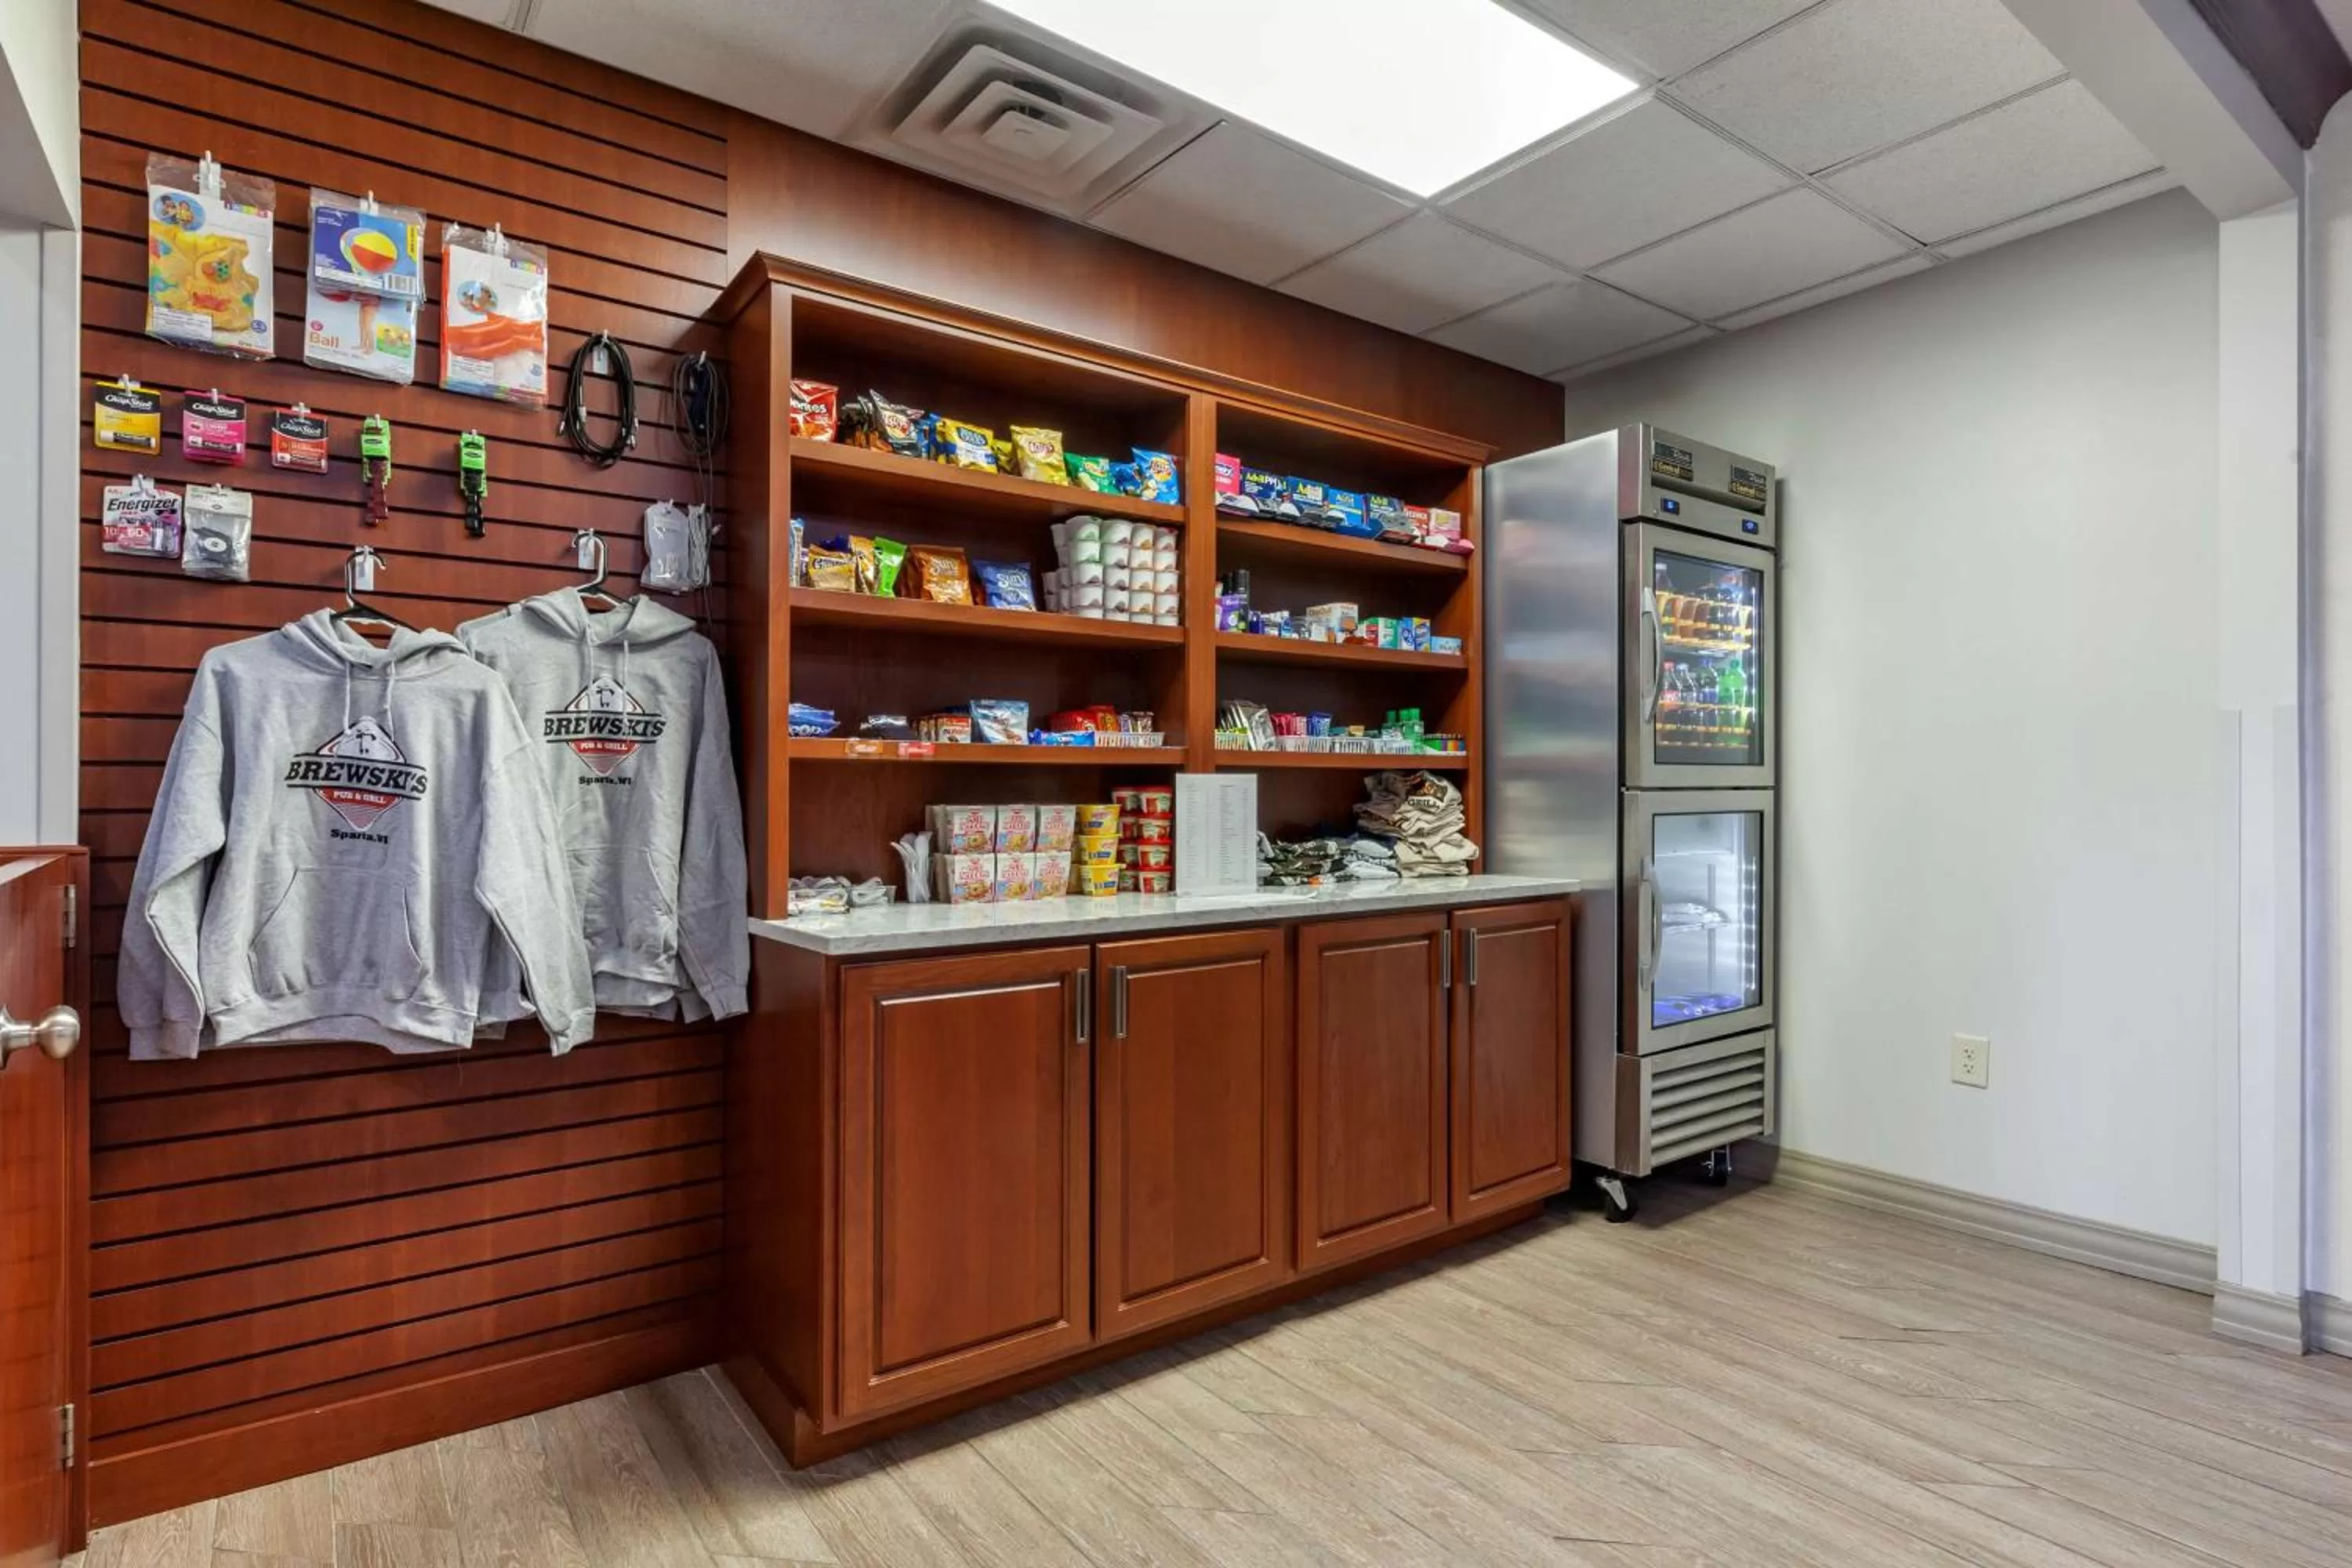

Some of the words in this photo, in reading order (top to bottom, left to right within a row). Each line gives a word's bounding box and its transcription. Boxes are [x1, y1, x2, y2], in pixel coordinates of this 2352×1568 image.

[310, 331, 339, 348] Ball
[107, 498, 178, 512] Energizer
[285, 760, 427, 794] BREWSKI'S
